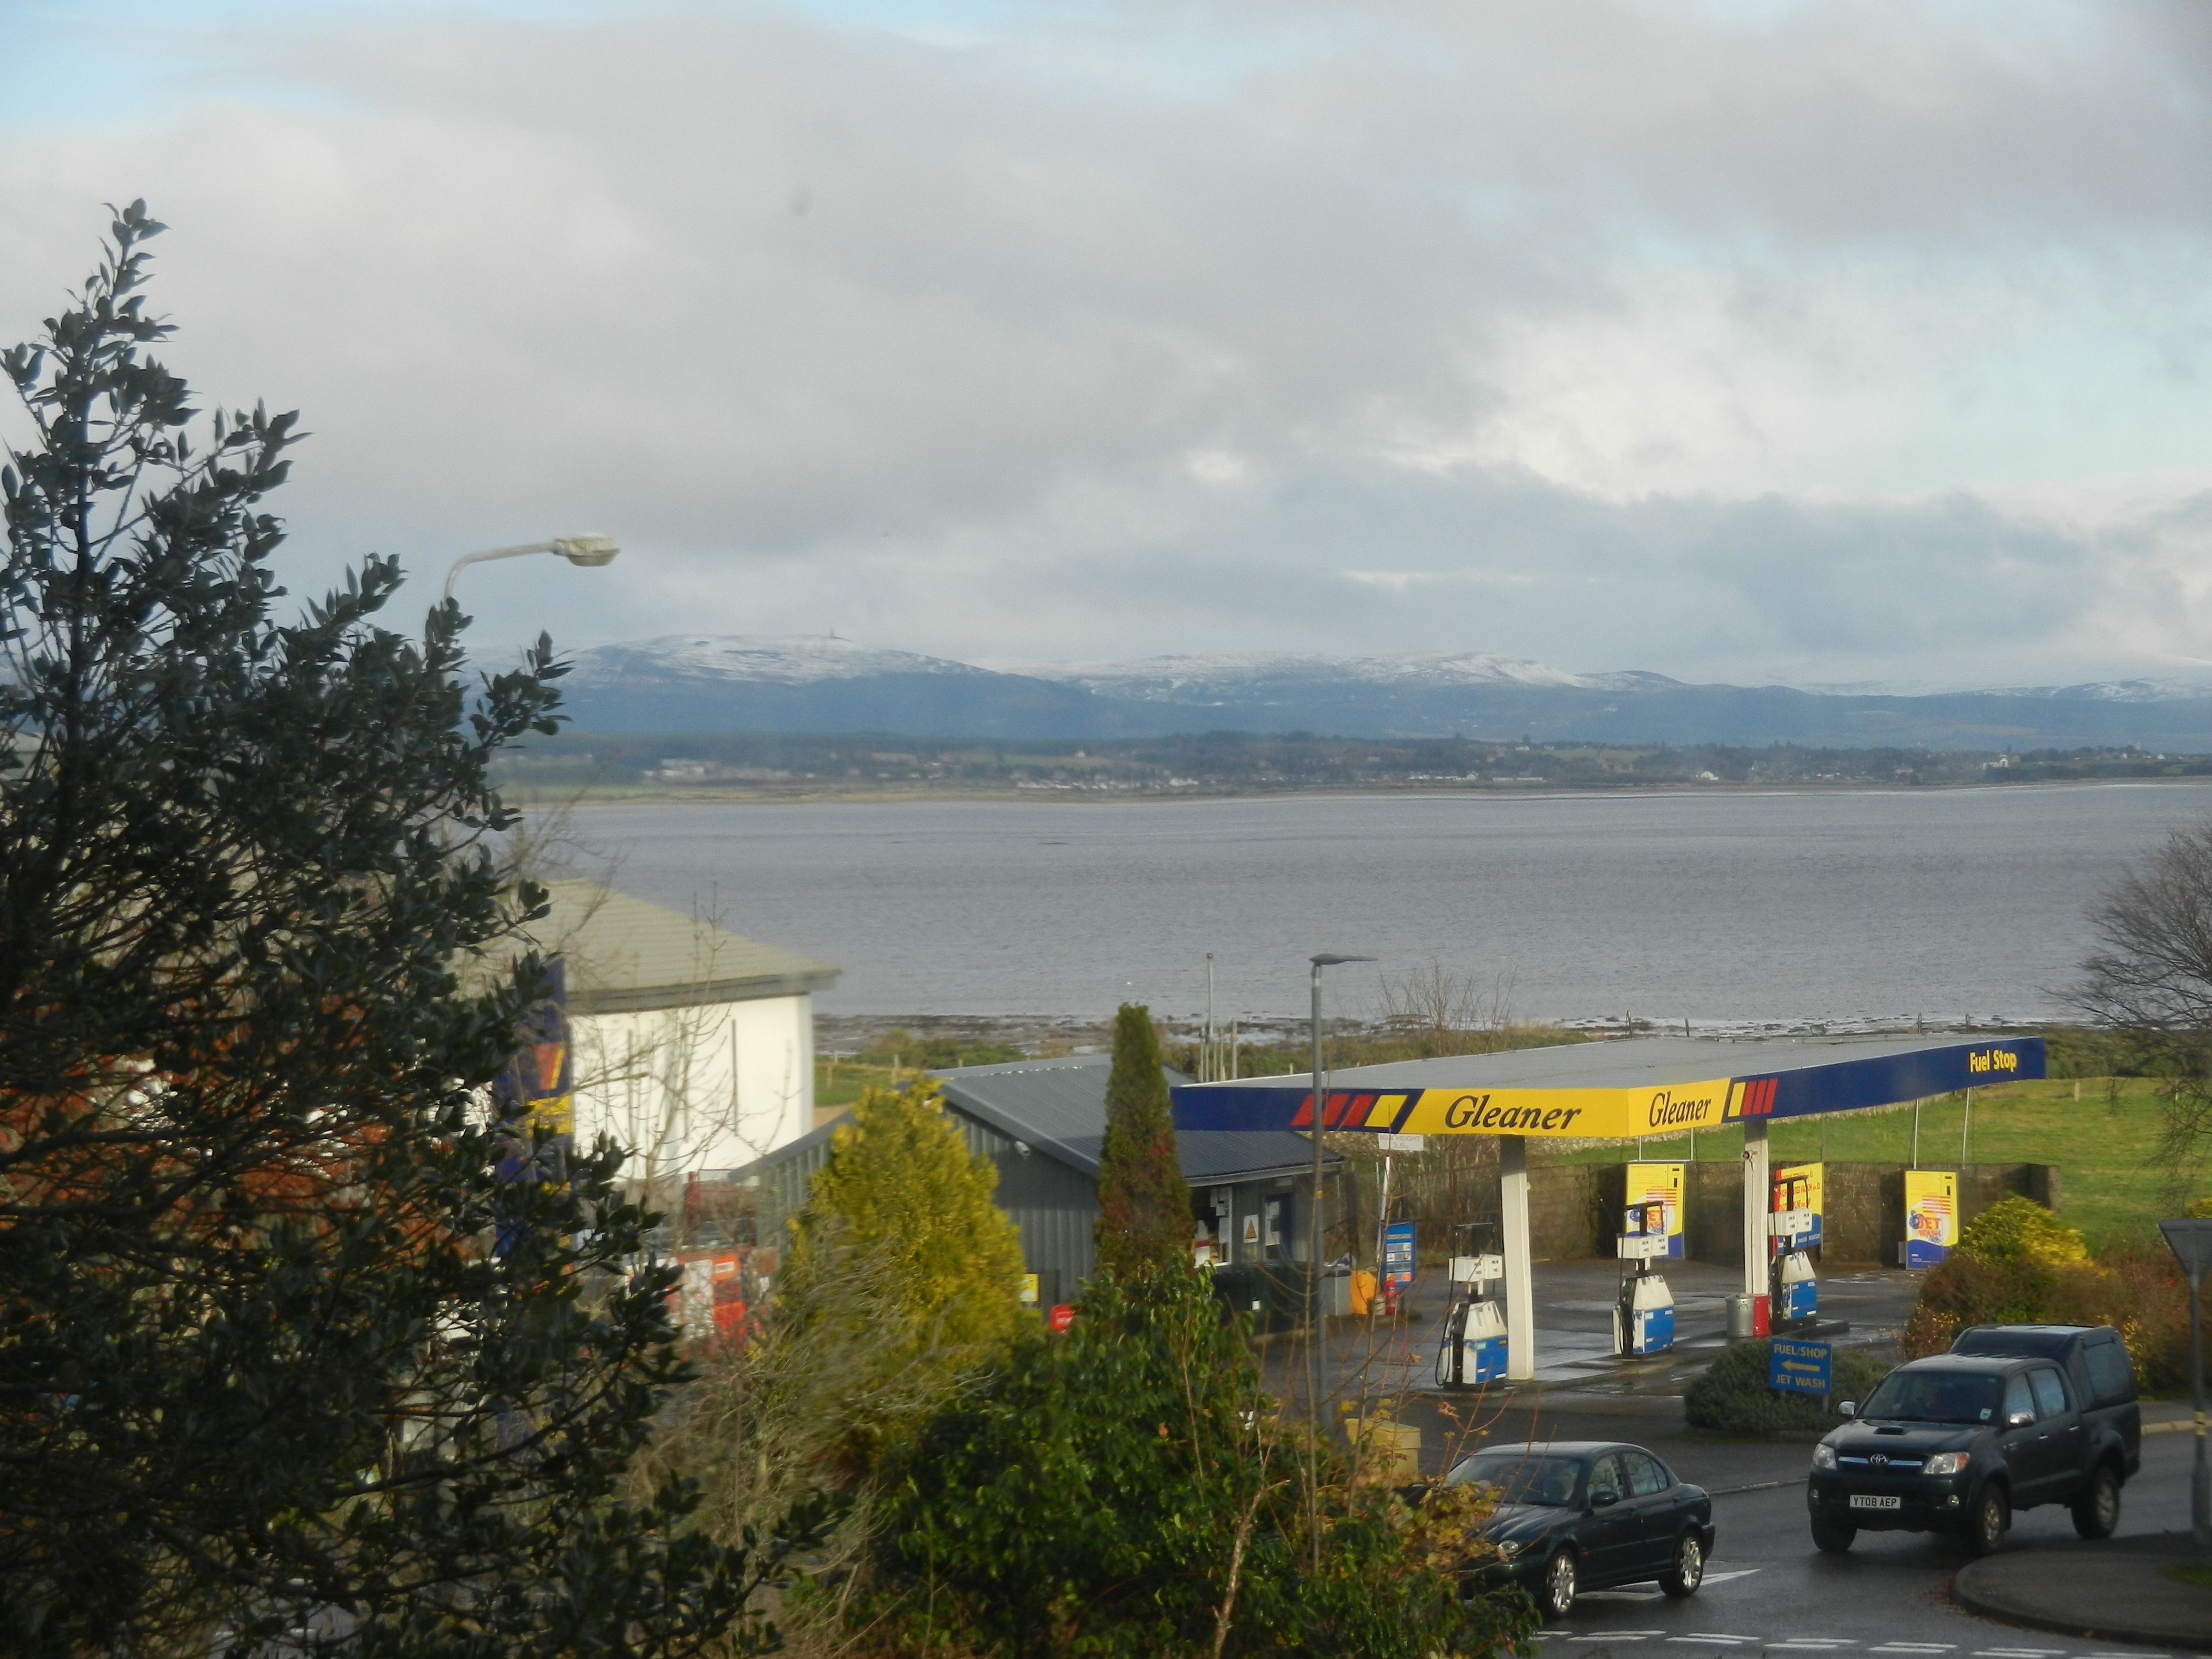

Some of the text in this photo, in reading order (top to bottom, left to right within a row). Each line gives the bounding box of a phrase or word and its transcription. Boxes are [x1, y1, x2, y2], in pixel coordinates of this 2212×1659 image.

[1969, 1049, 2017, 1073] Fuel Stop
[1445, 1094, 1582, 1130] Gleaner
[1649, 1090, 1711, 1127] Gleaner
[1918, 1216, 1941, 1230] JET
[1774, 1343, 1827, 1358] FUEL/SHOP
[1776, 1374, 1825, 1389] JET WASH
[1854, 1497, 1896, 1507] YT08 AEP
